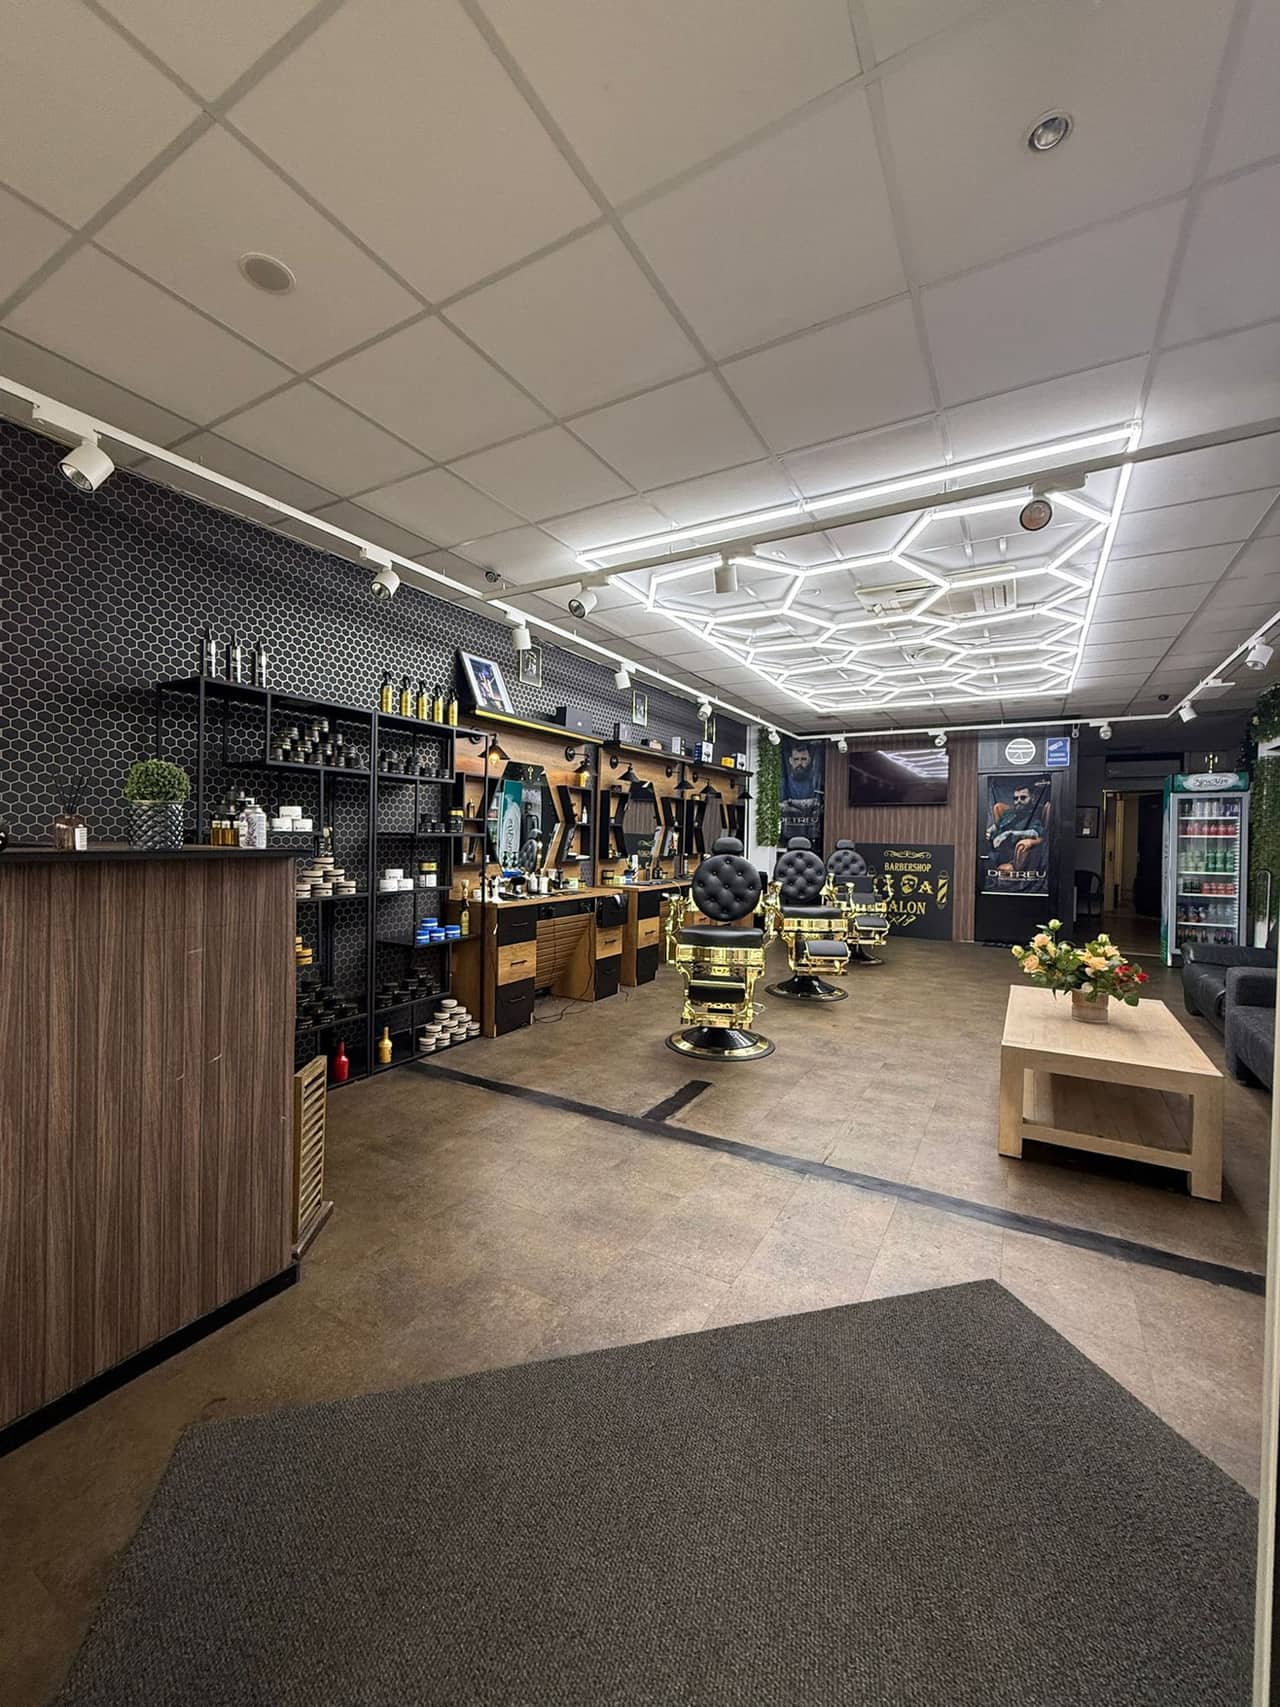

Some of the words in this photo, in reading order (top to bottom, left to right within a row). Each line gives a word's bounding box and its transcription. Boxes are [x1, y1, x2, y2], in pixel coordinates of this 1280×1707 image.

[884, 862, 932, 872] BARBERSHOP
[987, 869, 1047, 878] DETREU
[888, 900, 926, 915] ALON
